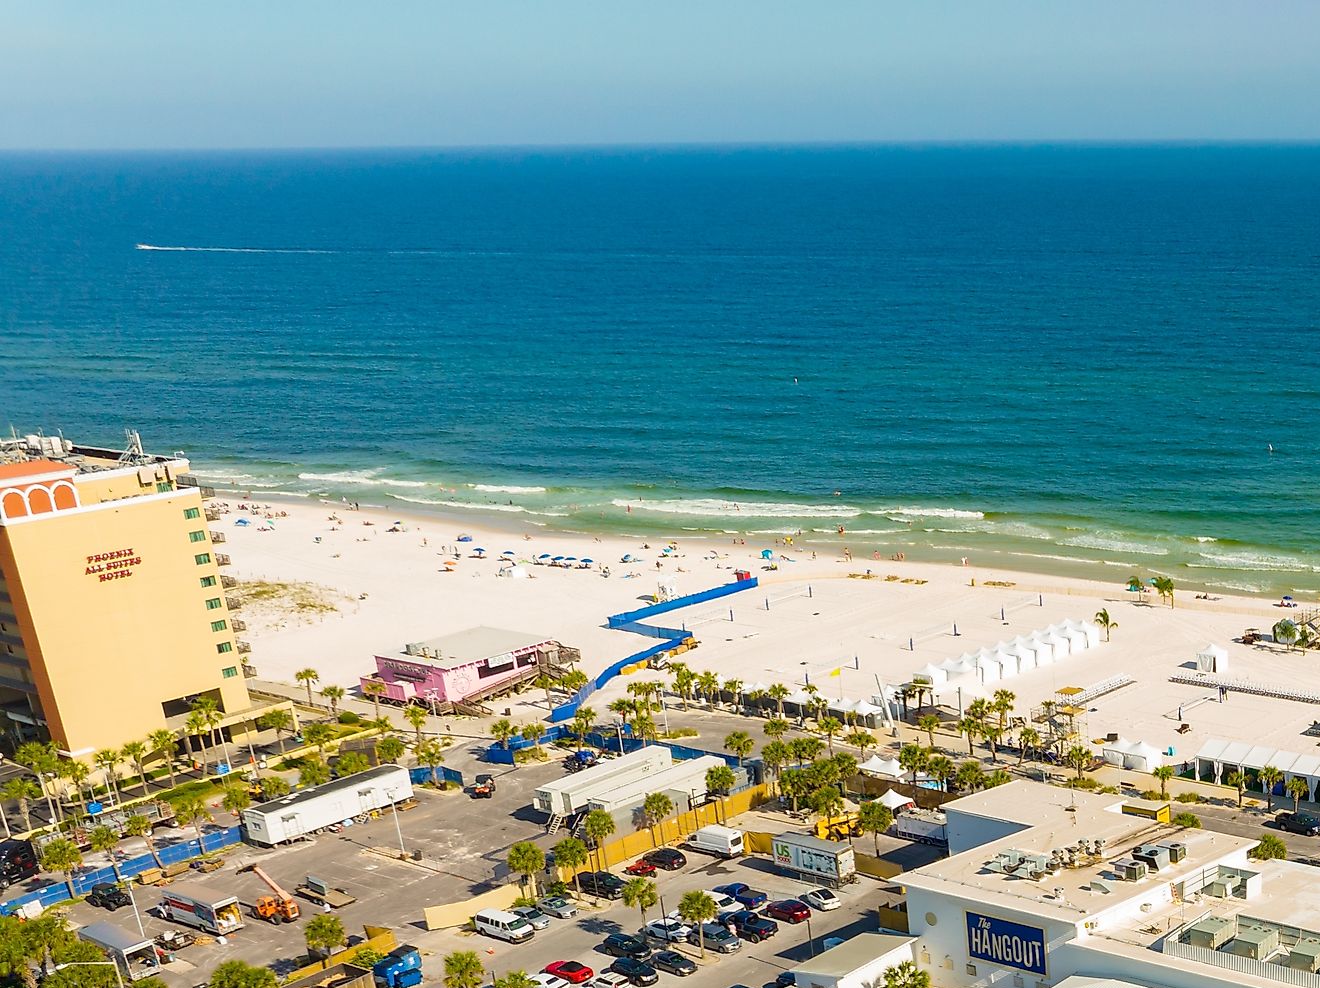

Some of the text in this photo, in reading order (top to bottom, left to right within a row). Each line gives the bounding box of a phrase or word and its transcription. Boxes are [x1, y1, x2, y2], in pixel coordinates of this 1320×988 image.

[87, 548, 134, 564] PHOENIX
[85, 556, 141, 575] ALL SUITES
[98, 569, 132, 582] HOTEL
[977, 917, 992, 930] The
[971, 927, 1041, 968] HANGOUT
